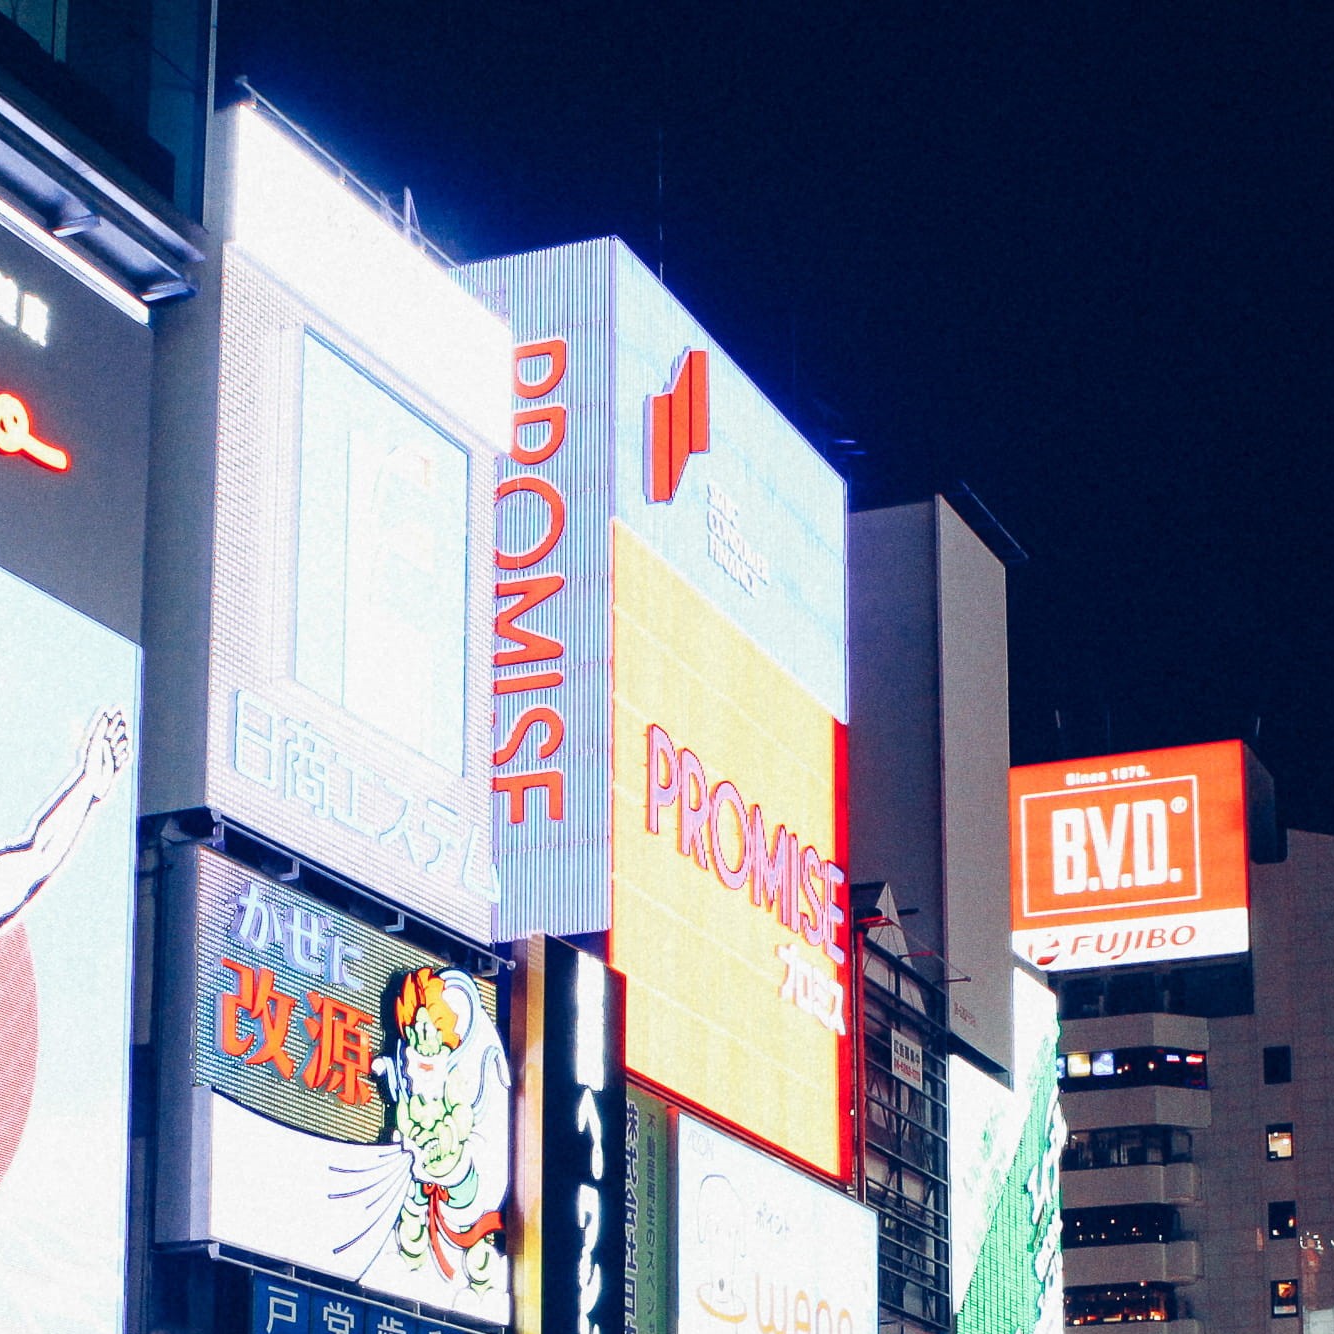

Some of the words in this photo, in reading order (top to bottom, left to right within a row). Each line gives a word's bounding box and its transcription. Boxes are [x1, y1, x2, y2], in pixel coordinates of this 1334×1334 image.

[1065, 771, 1108, 787] Since
[643, 722, 846, 966] PROMISE
[1051, 798, 1183, 896] B.V.D.
[1071, 924, 1196, 961] FUJIBO
[220, 957, 374, 1108] 改源
